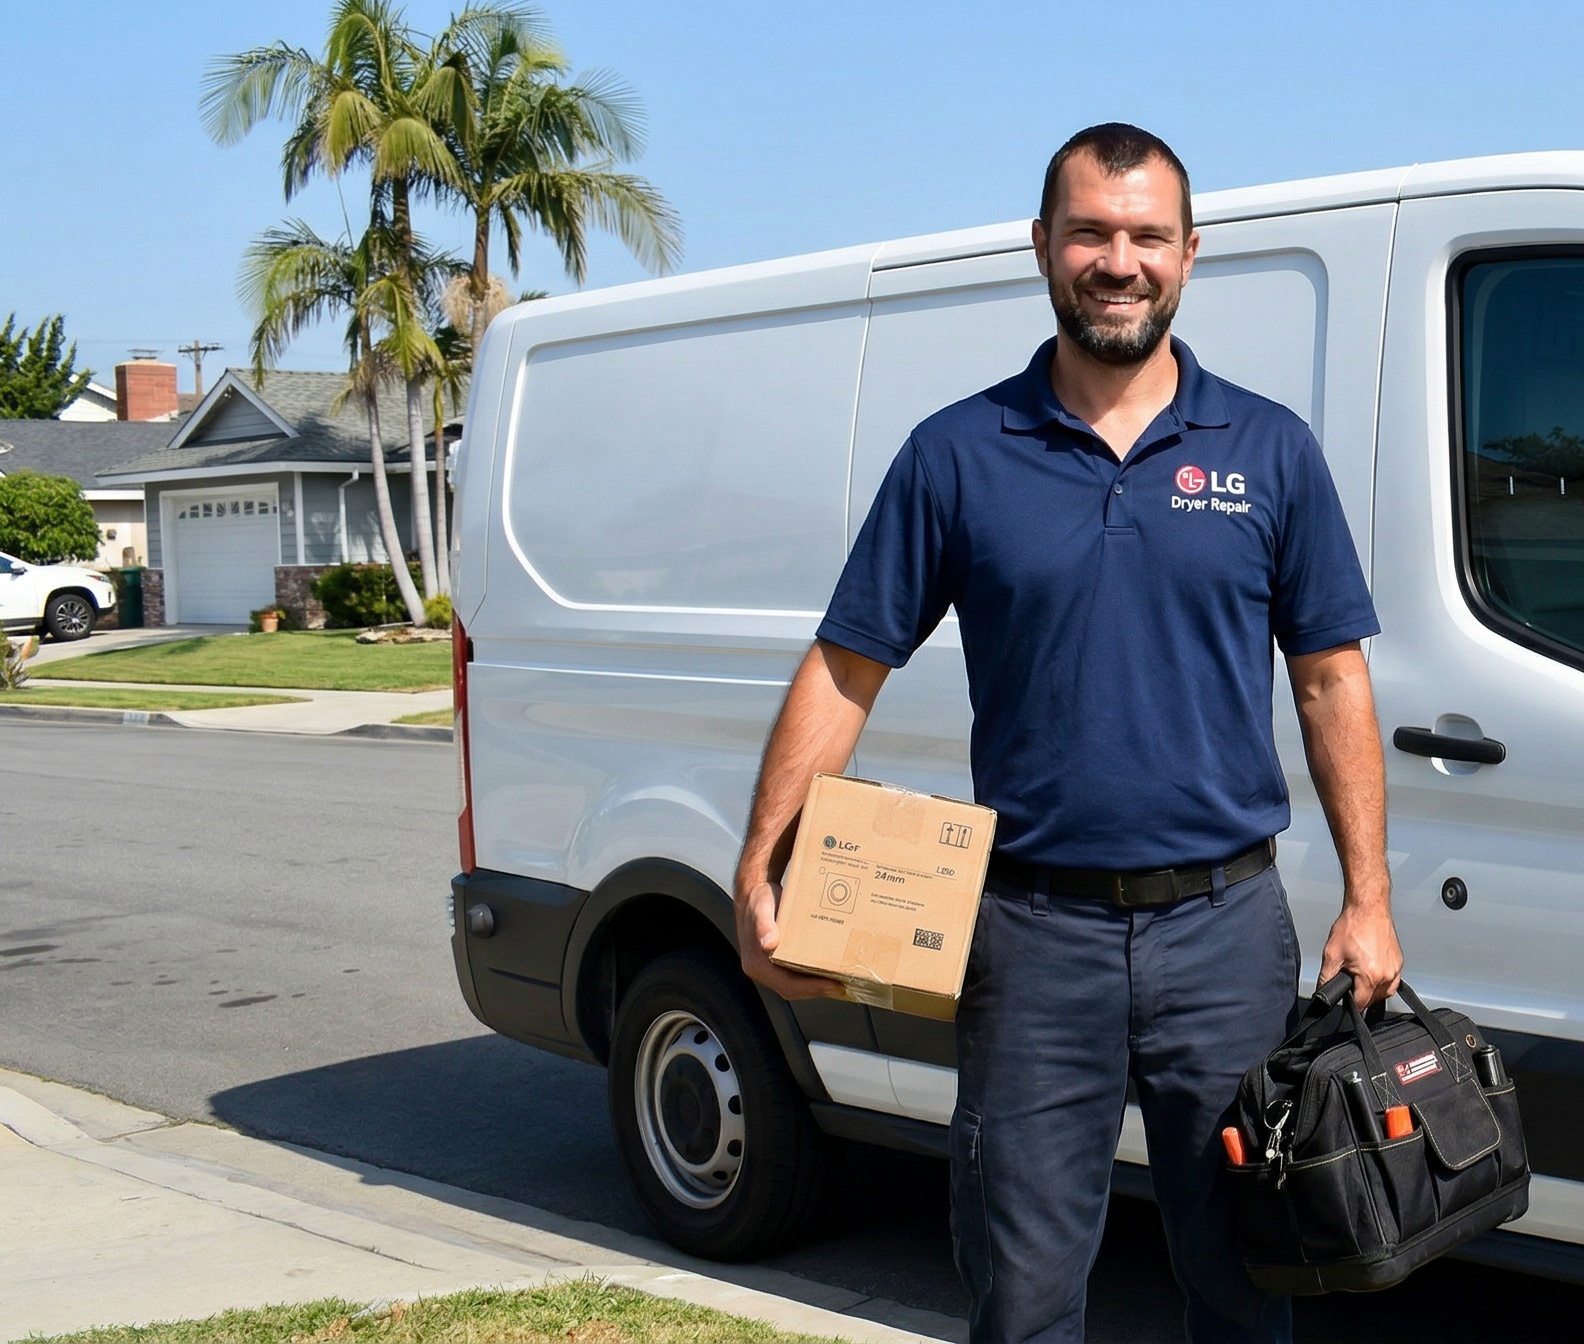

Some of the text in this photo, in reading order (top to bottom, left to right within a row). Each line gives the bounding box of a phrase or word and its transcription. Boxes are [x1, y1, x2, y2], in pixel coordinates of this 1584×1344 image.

[1210, 470, 1246, 495] LG
[1171, 495, 1252, 515] Dryer Repair
